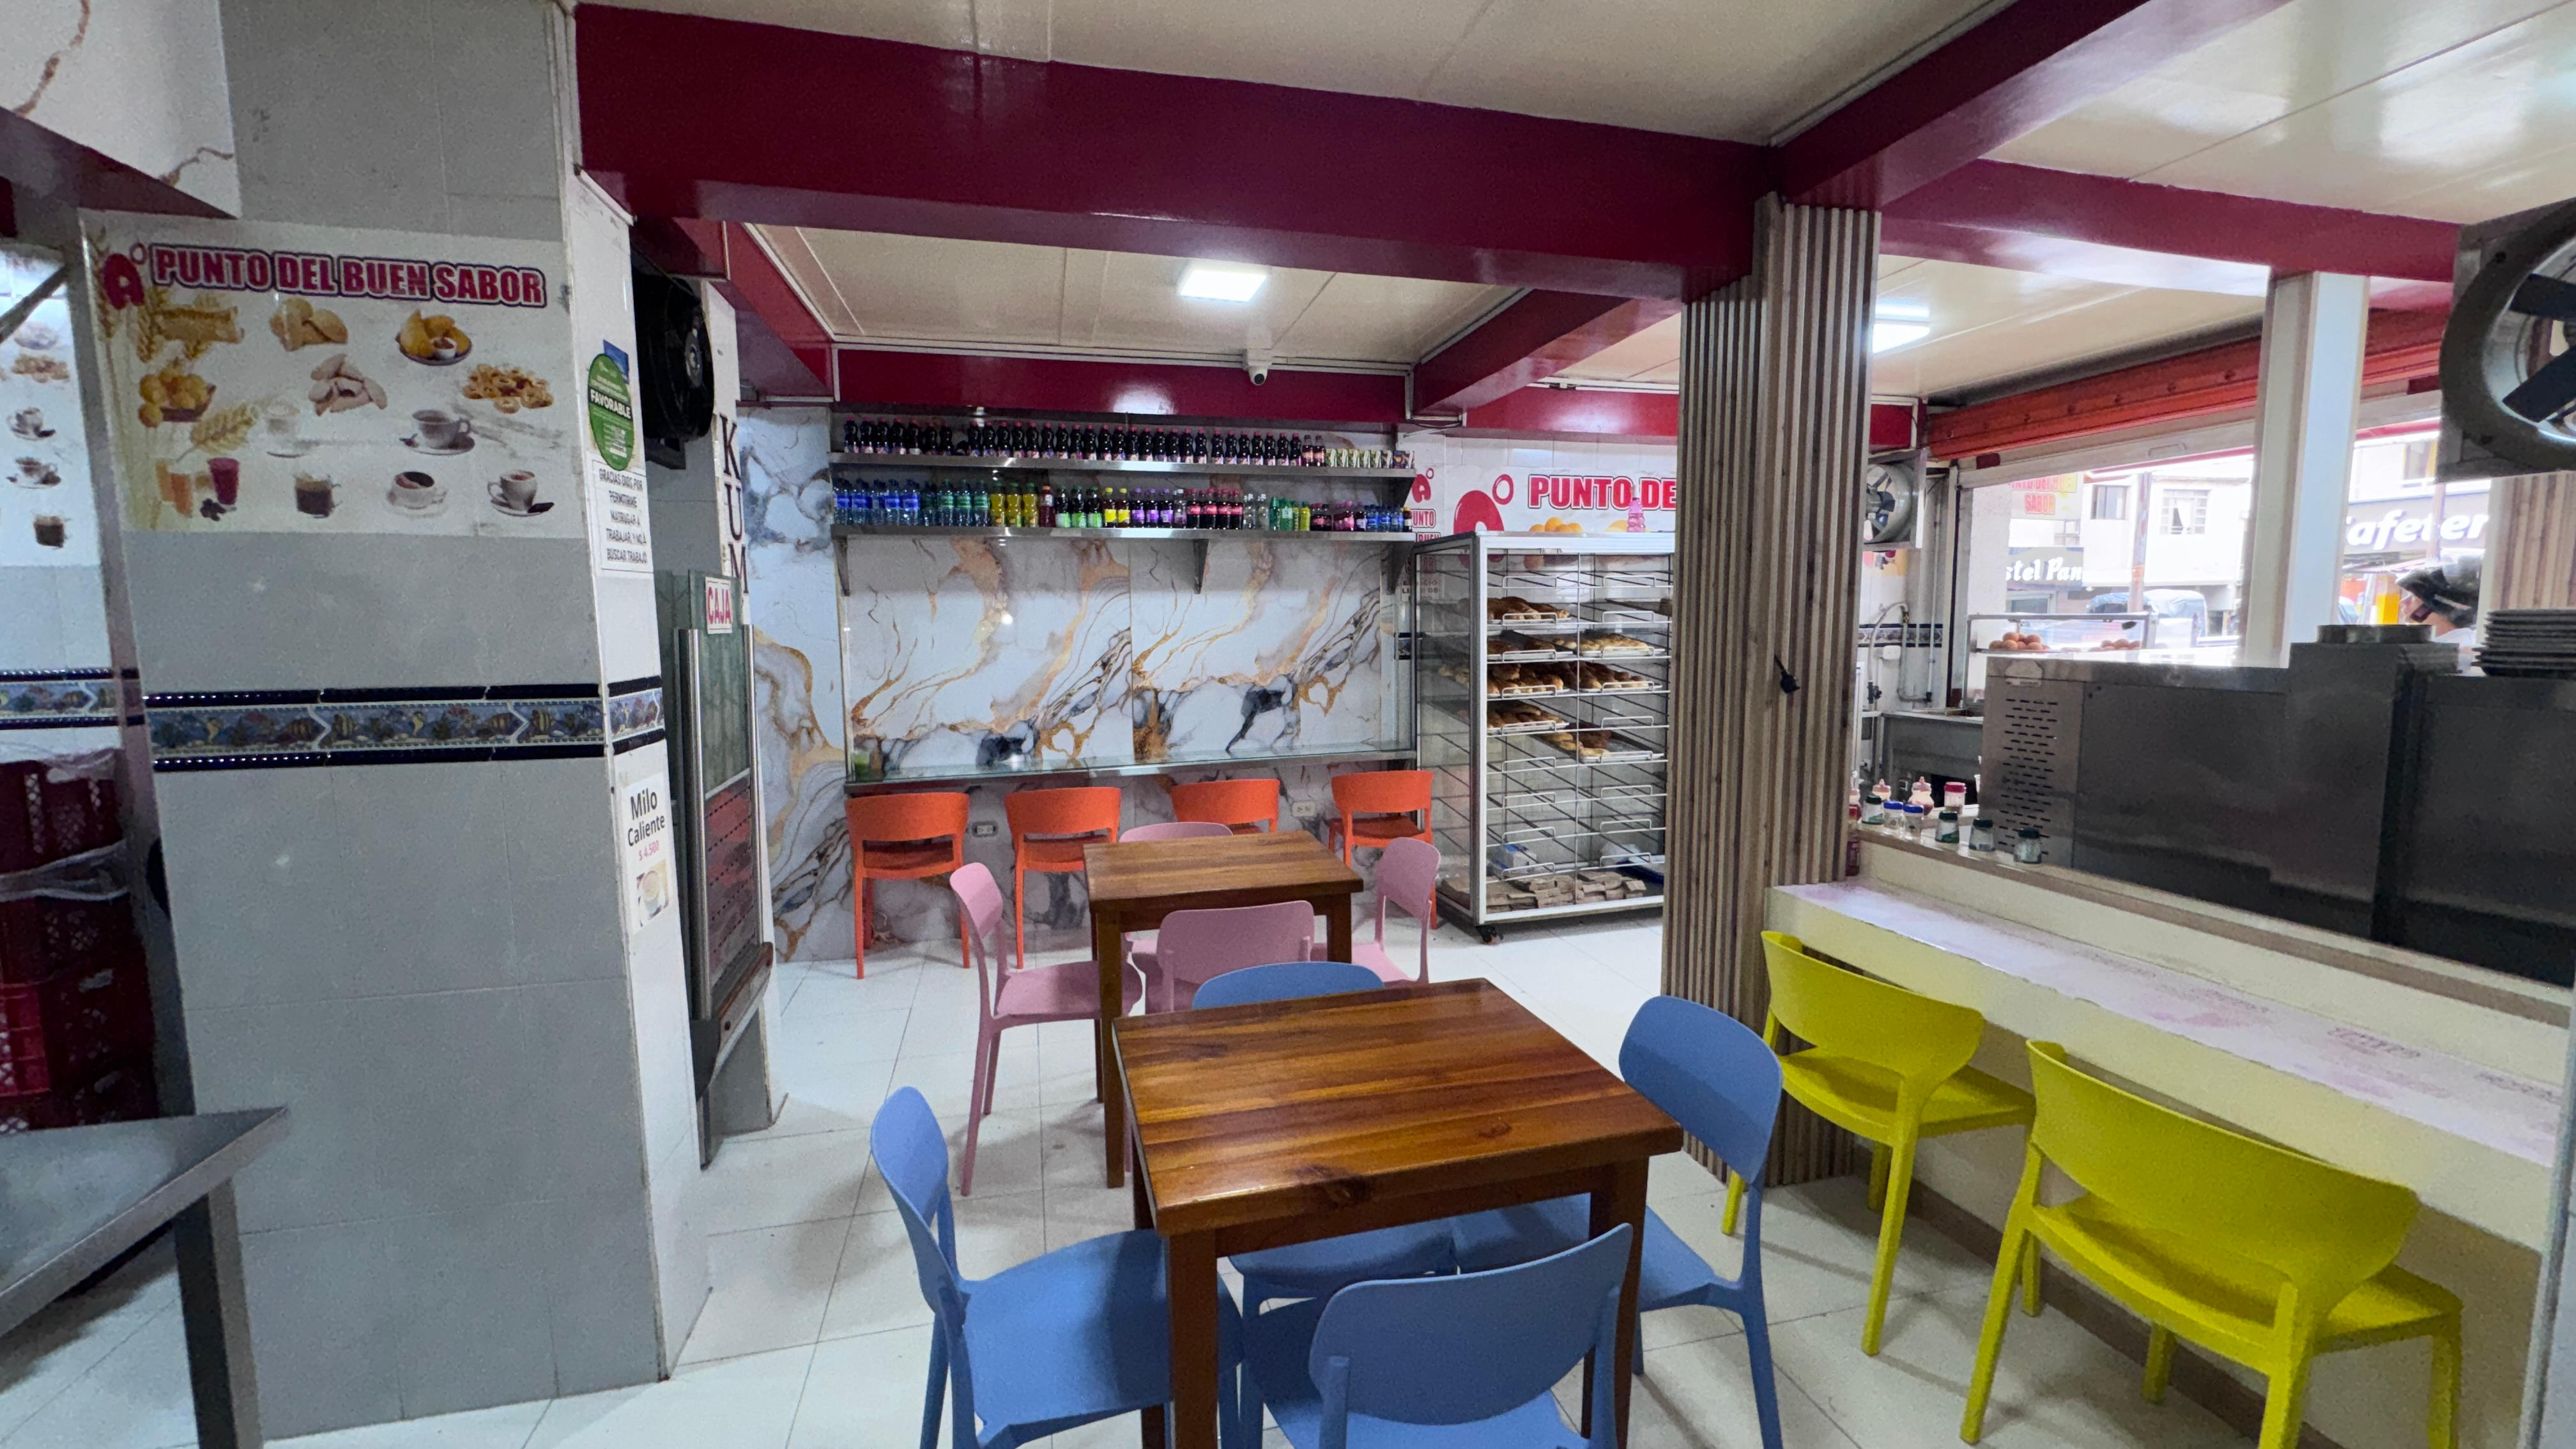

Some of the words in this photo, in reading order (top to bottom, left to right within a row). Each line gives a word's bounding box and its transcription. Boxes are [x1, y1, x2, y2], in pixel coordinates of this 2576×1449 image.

[155, 249, 270, 288] PUNTO
[278, 256, 336, 291] DEL
[342, 260, 429, 296] BUEN
[435, 266, 542, 303] SABOR
[590, 388, 631, 419] FAVORABLE
[599, 468, 620, 486] GRACIAS
[1529, 475, 1634, 510] PUNTO
[1411, 510, 1434, 526] UNTO
[2025, 494, 2055, 514] SABOR
[2345, 509, 2490, 551] afeter
[607, 548, 626, 562] BUSCAR
[707, 586, 732, 624] CAJA
[630, 787, 658, 820] Milo
[627, 815, 666, 847] Caliente
